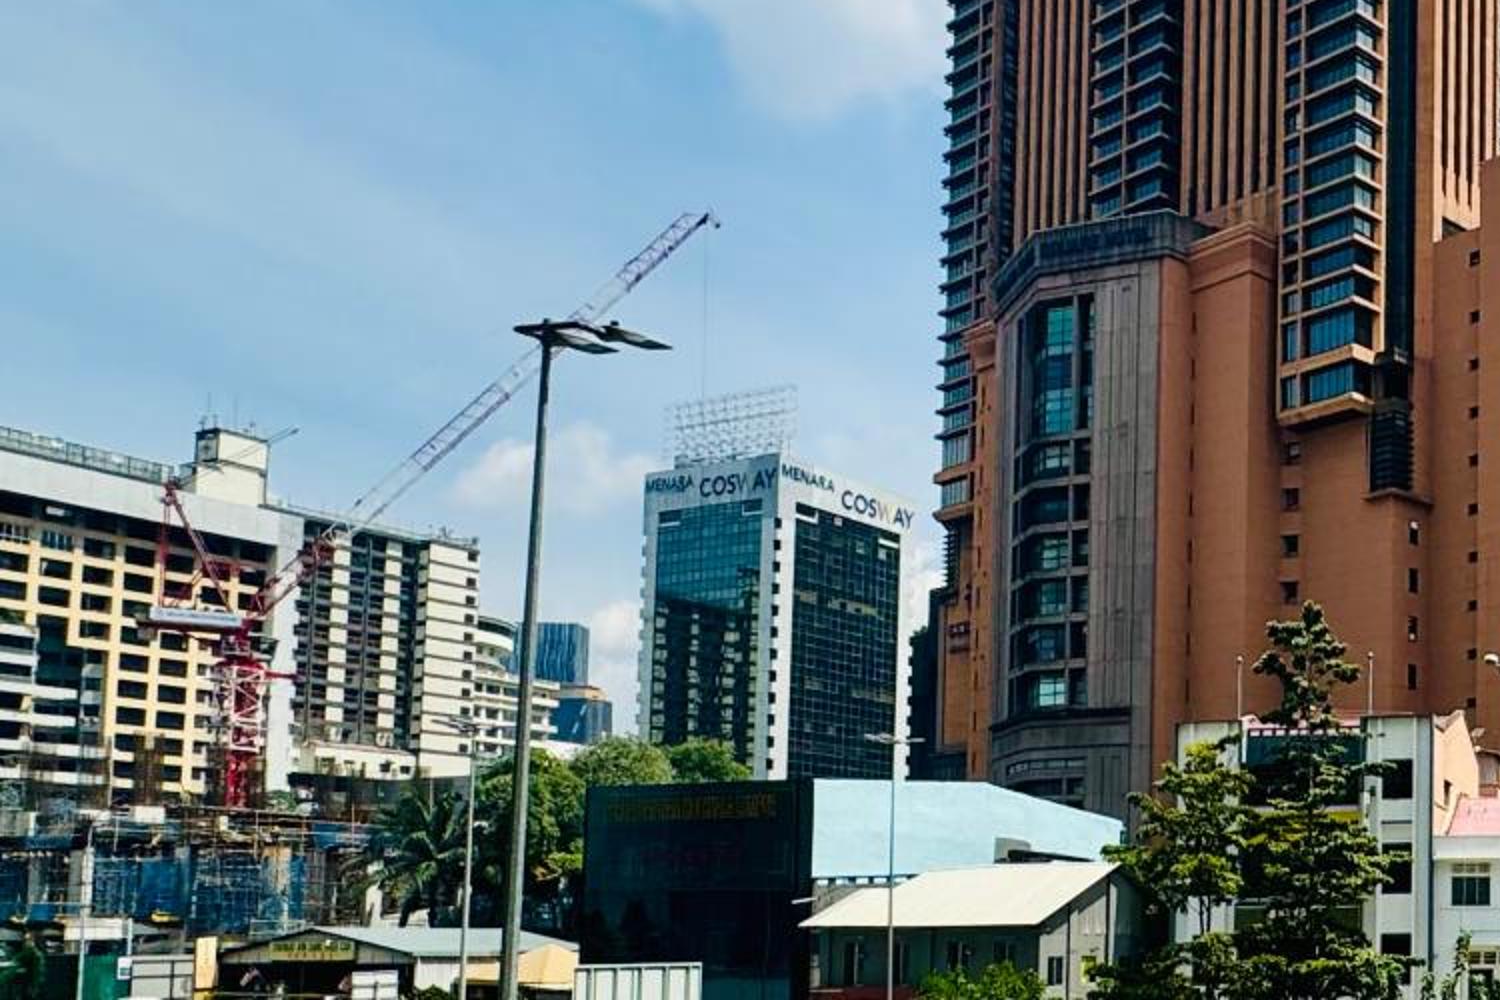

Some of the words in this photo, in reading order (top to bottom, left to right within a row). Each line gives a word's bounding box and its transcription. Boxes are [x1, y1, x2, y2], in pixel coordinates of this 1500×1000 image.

[645, 474, 695, 493] MENARA
[700, 467, 778, 498] COSWAY
[782, 463, 835, 493] MENARA
[841, 489, 914, 529] COSWAY
